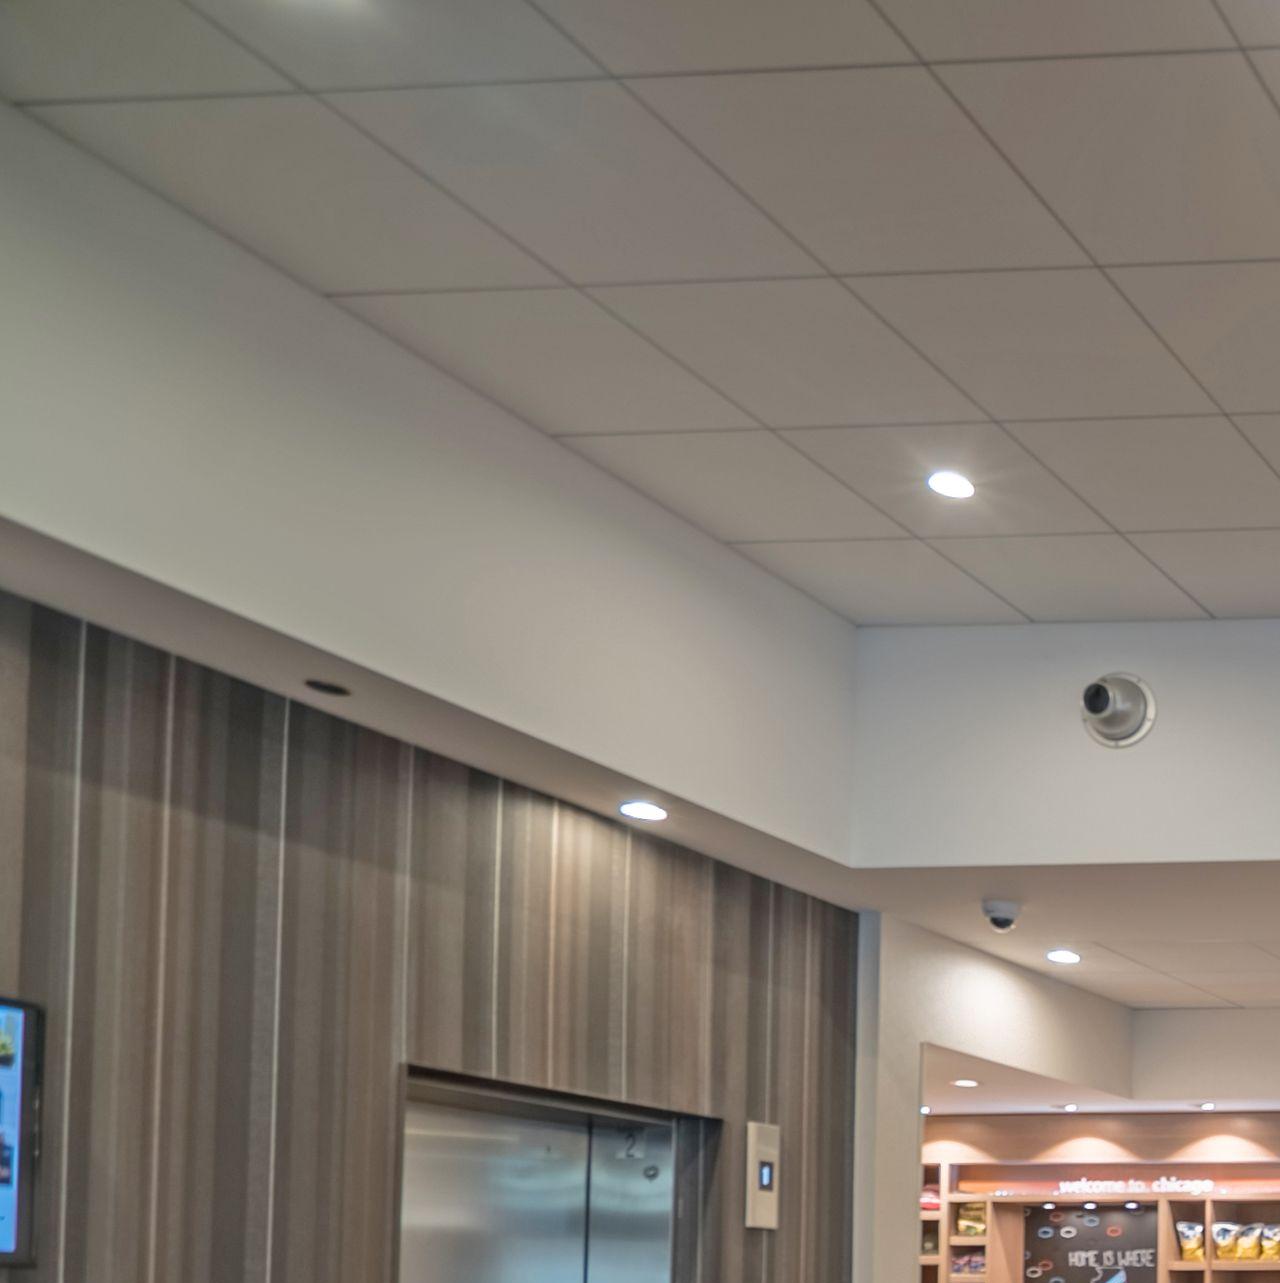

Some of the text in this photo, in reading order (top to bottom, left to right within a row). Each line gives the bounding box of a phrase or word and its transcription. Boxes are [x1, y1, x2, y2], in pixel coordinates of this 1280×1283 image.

[1059, 1177, 1126, 1194] welcome
[1152, 1176, 1214, 1195] chicago
[1068, 1248, 1156, 1268] HOME IS WHERE
